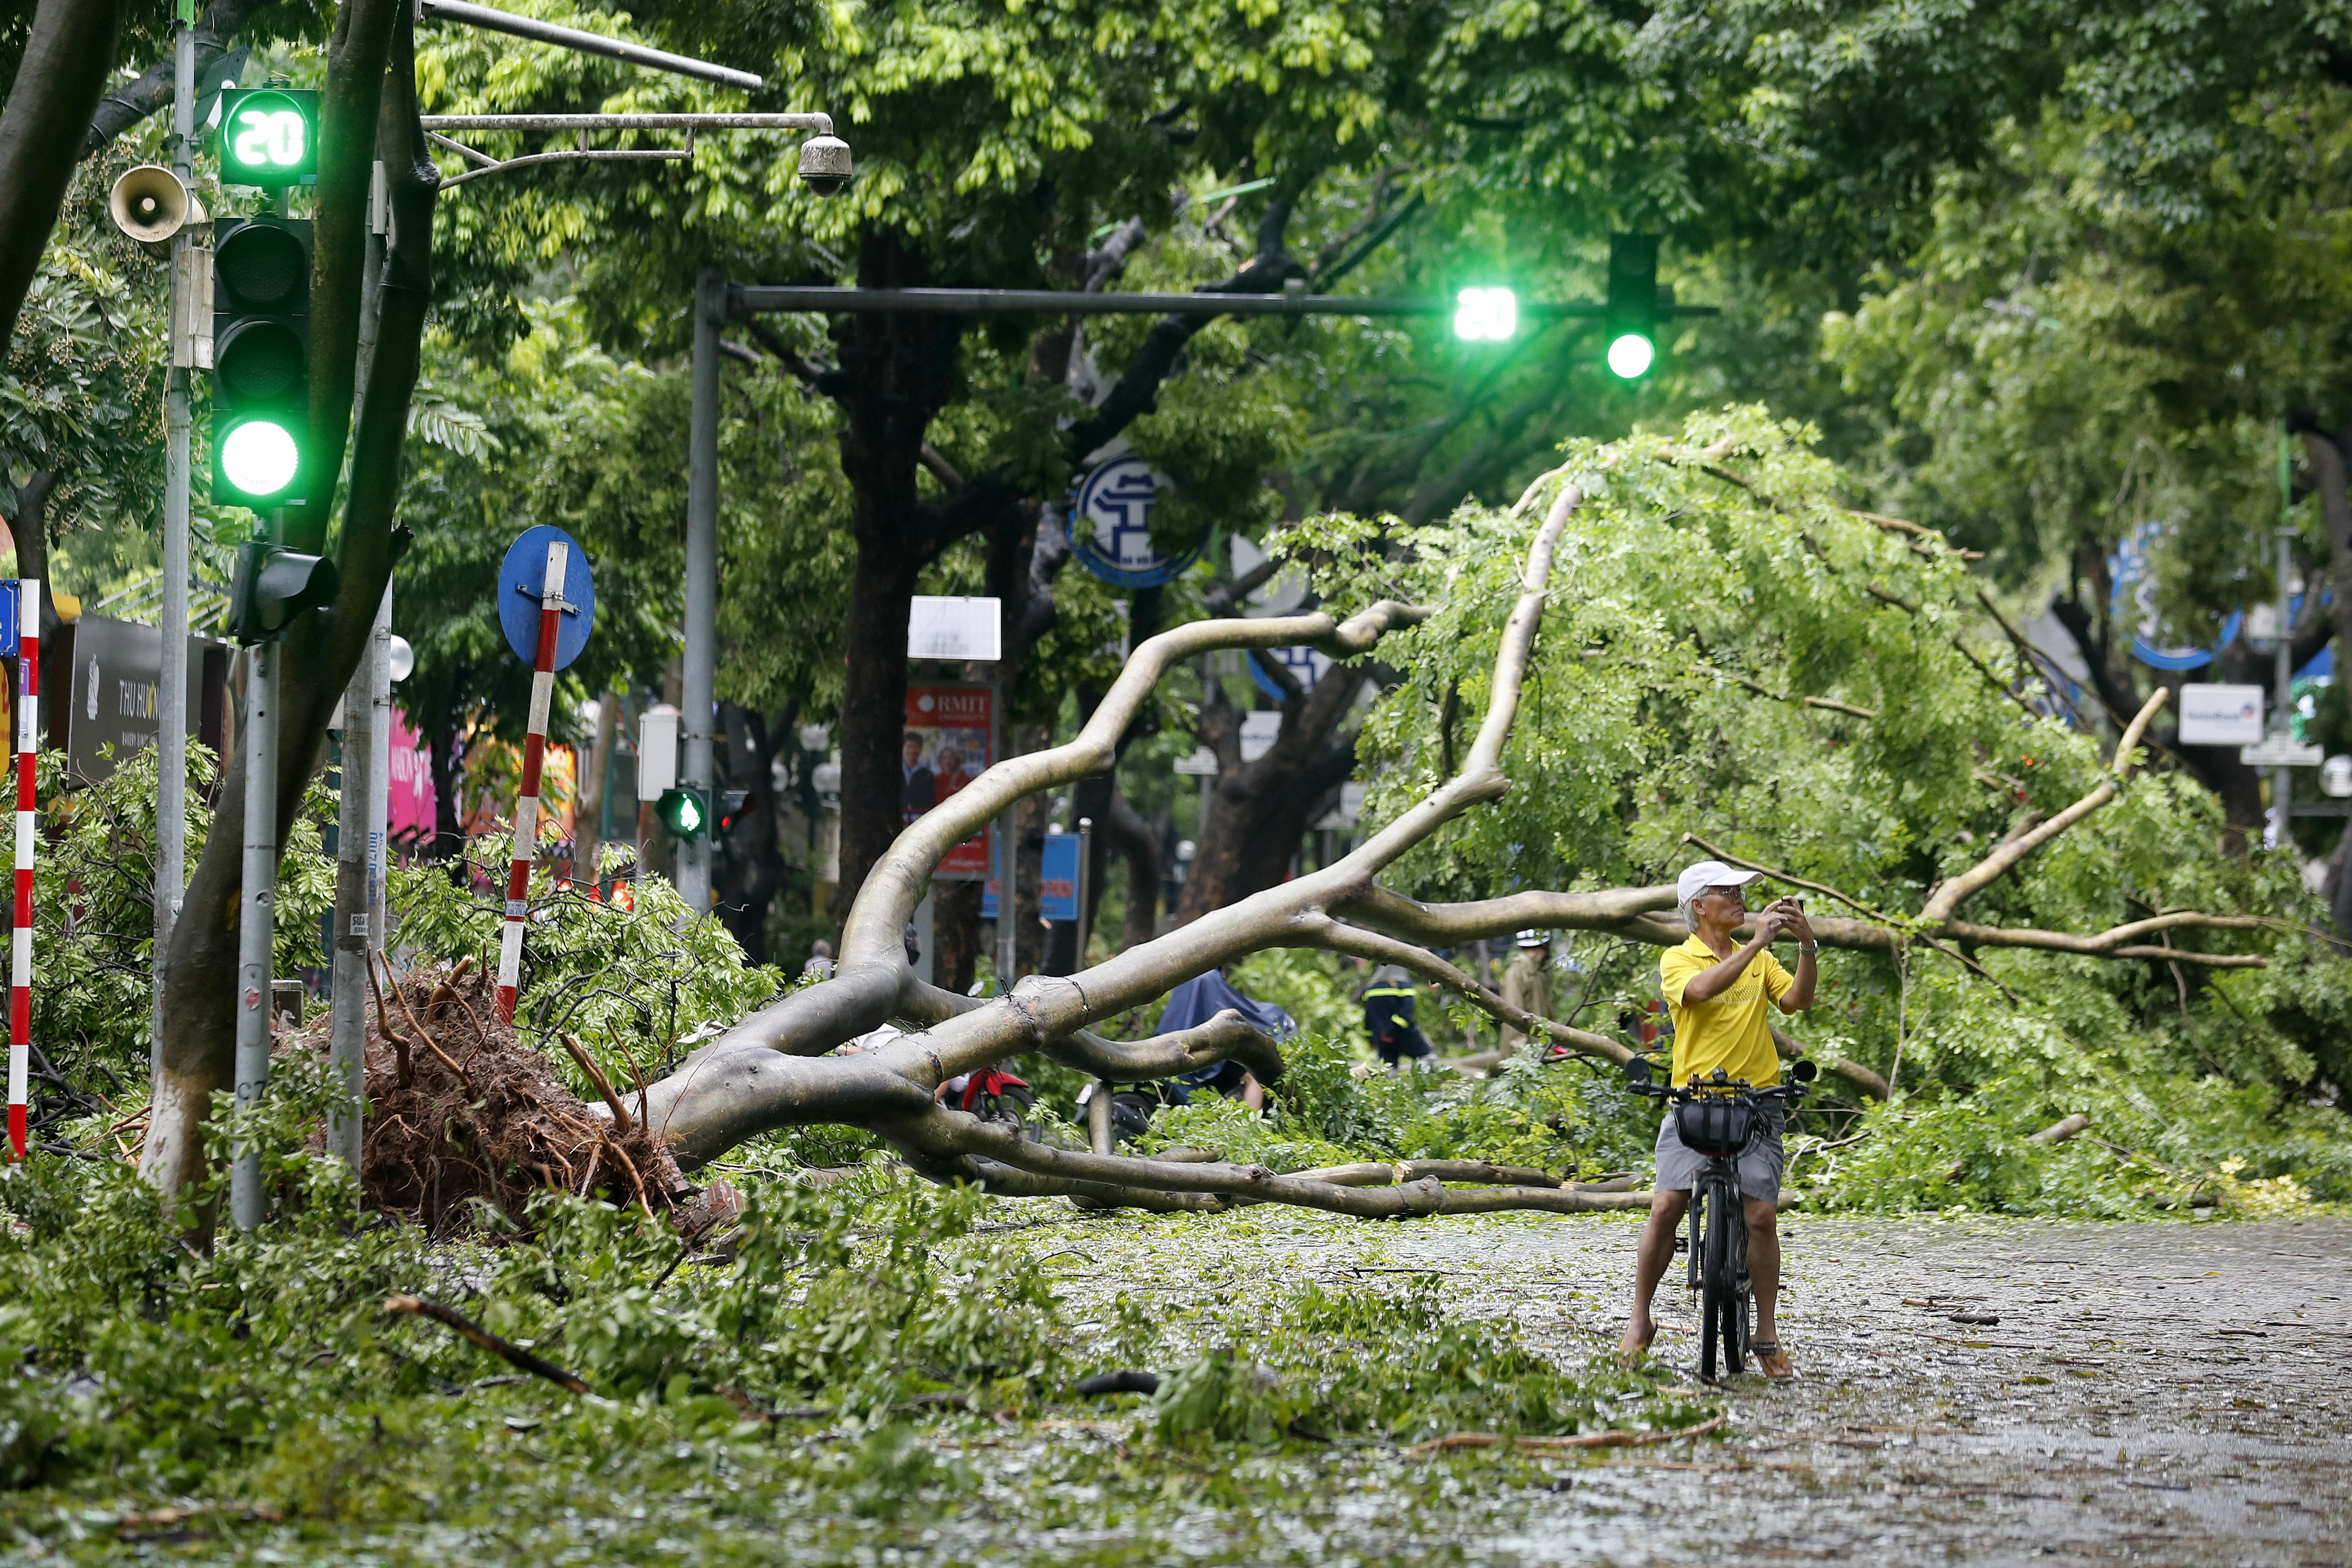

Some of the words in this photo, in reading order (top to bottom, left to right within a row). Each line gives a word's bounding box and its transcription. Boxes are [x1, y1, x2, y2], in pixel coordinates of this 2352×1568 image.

[236, 111, 303, 164] 20
[1455, 288, 1515, 339] 20
[119, 679, 136, 718] THU
[937, 695, 985, 712] RMIT
[238, 1080, 267, 1101] C7
